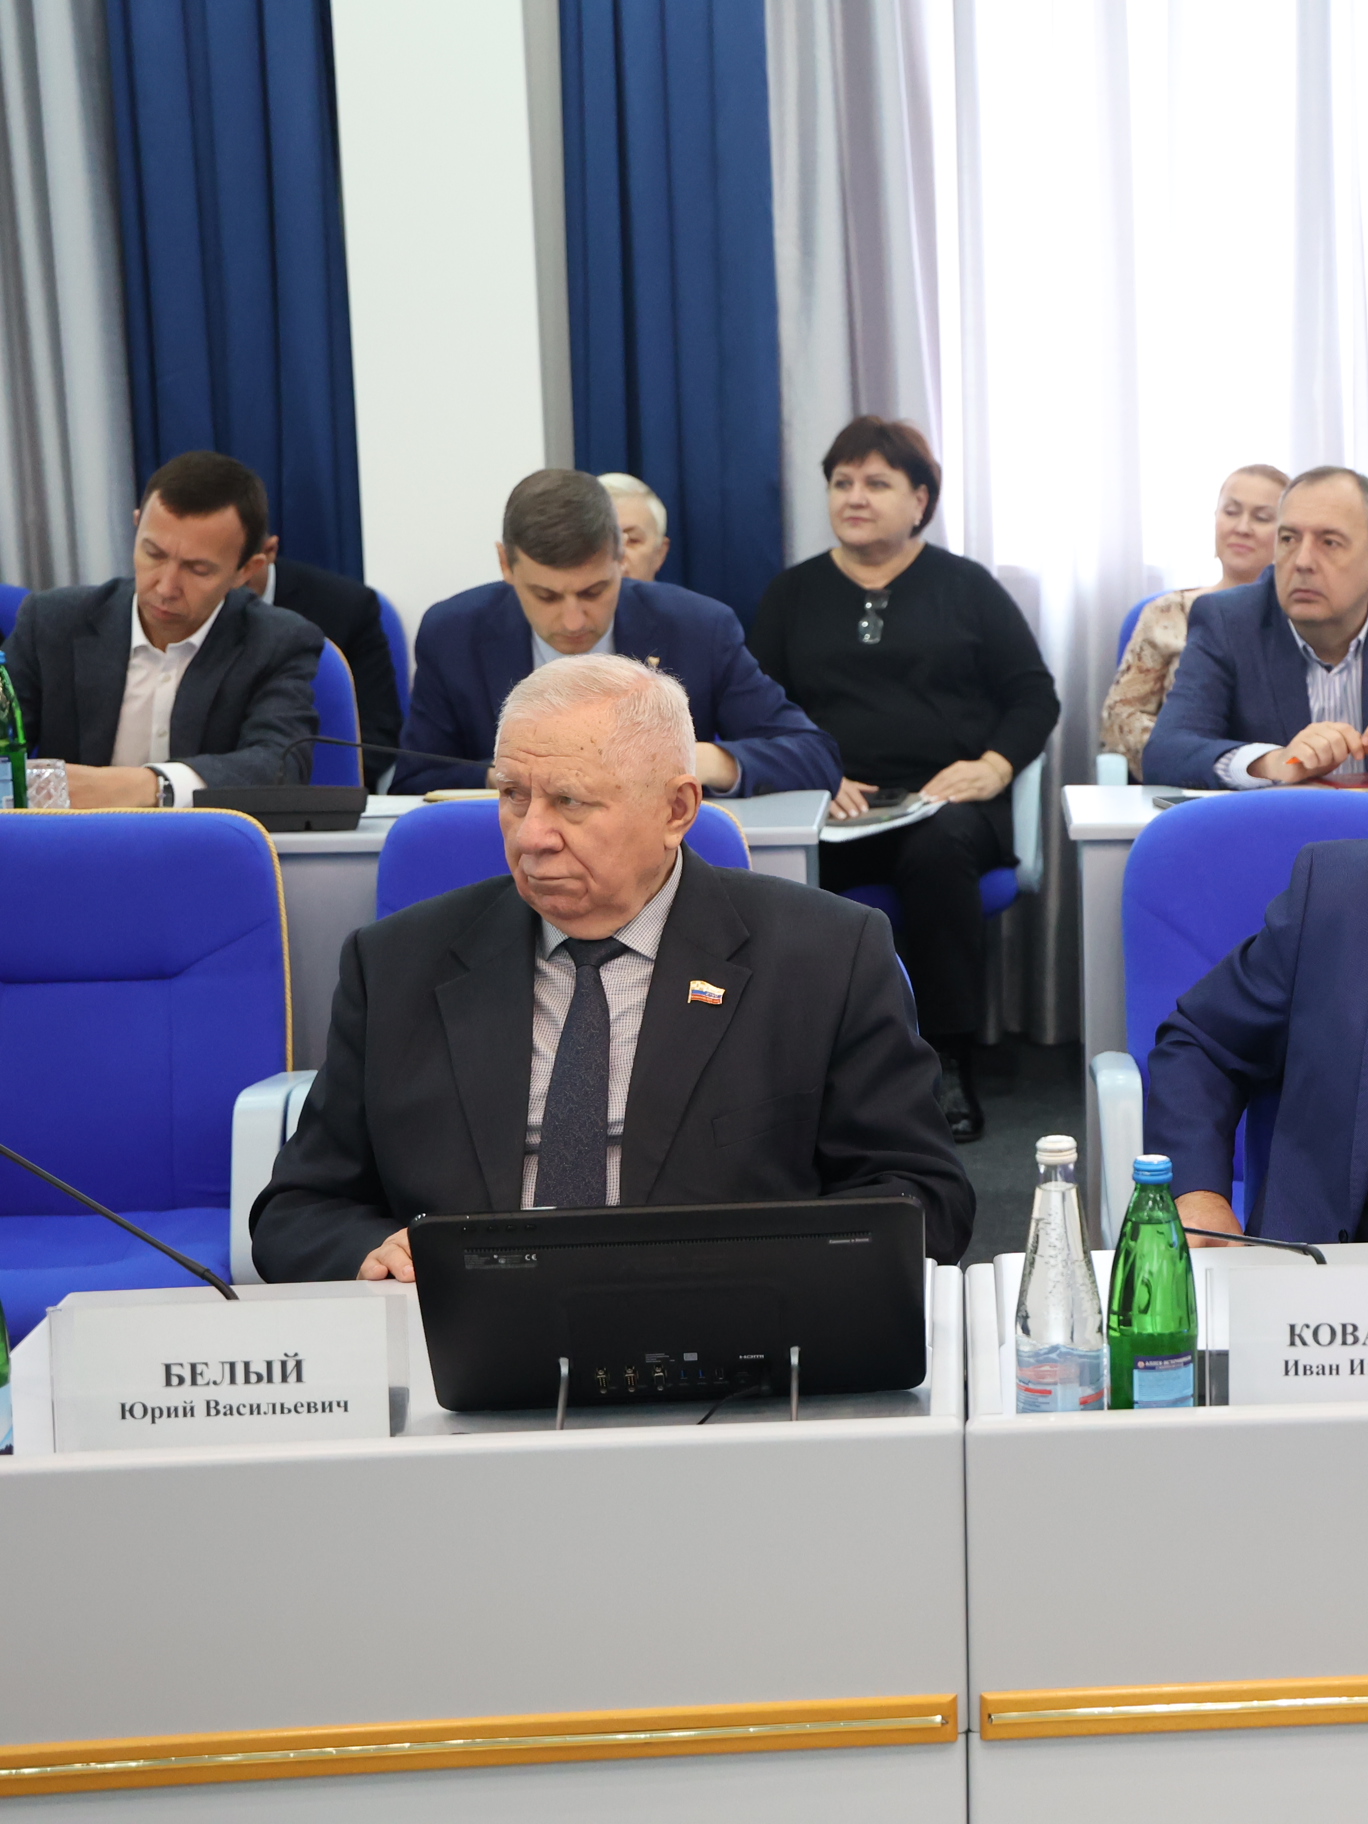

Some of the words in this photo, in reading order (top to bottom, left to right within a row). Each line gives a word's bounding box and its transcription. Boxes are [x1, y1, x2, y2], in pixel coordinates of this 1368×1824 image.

[162, 1352, 305, 1387] БЕЛЫЙ
[1283, 1359, 1340, 1376] Иван
[119, 1400, 196, 1425] Юрий
[204, 1399, 349, 1417] Васильевич
